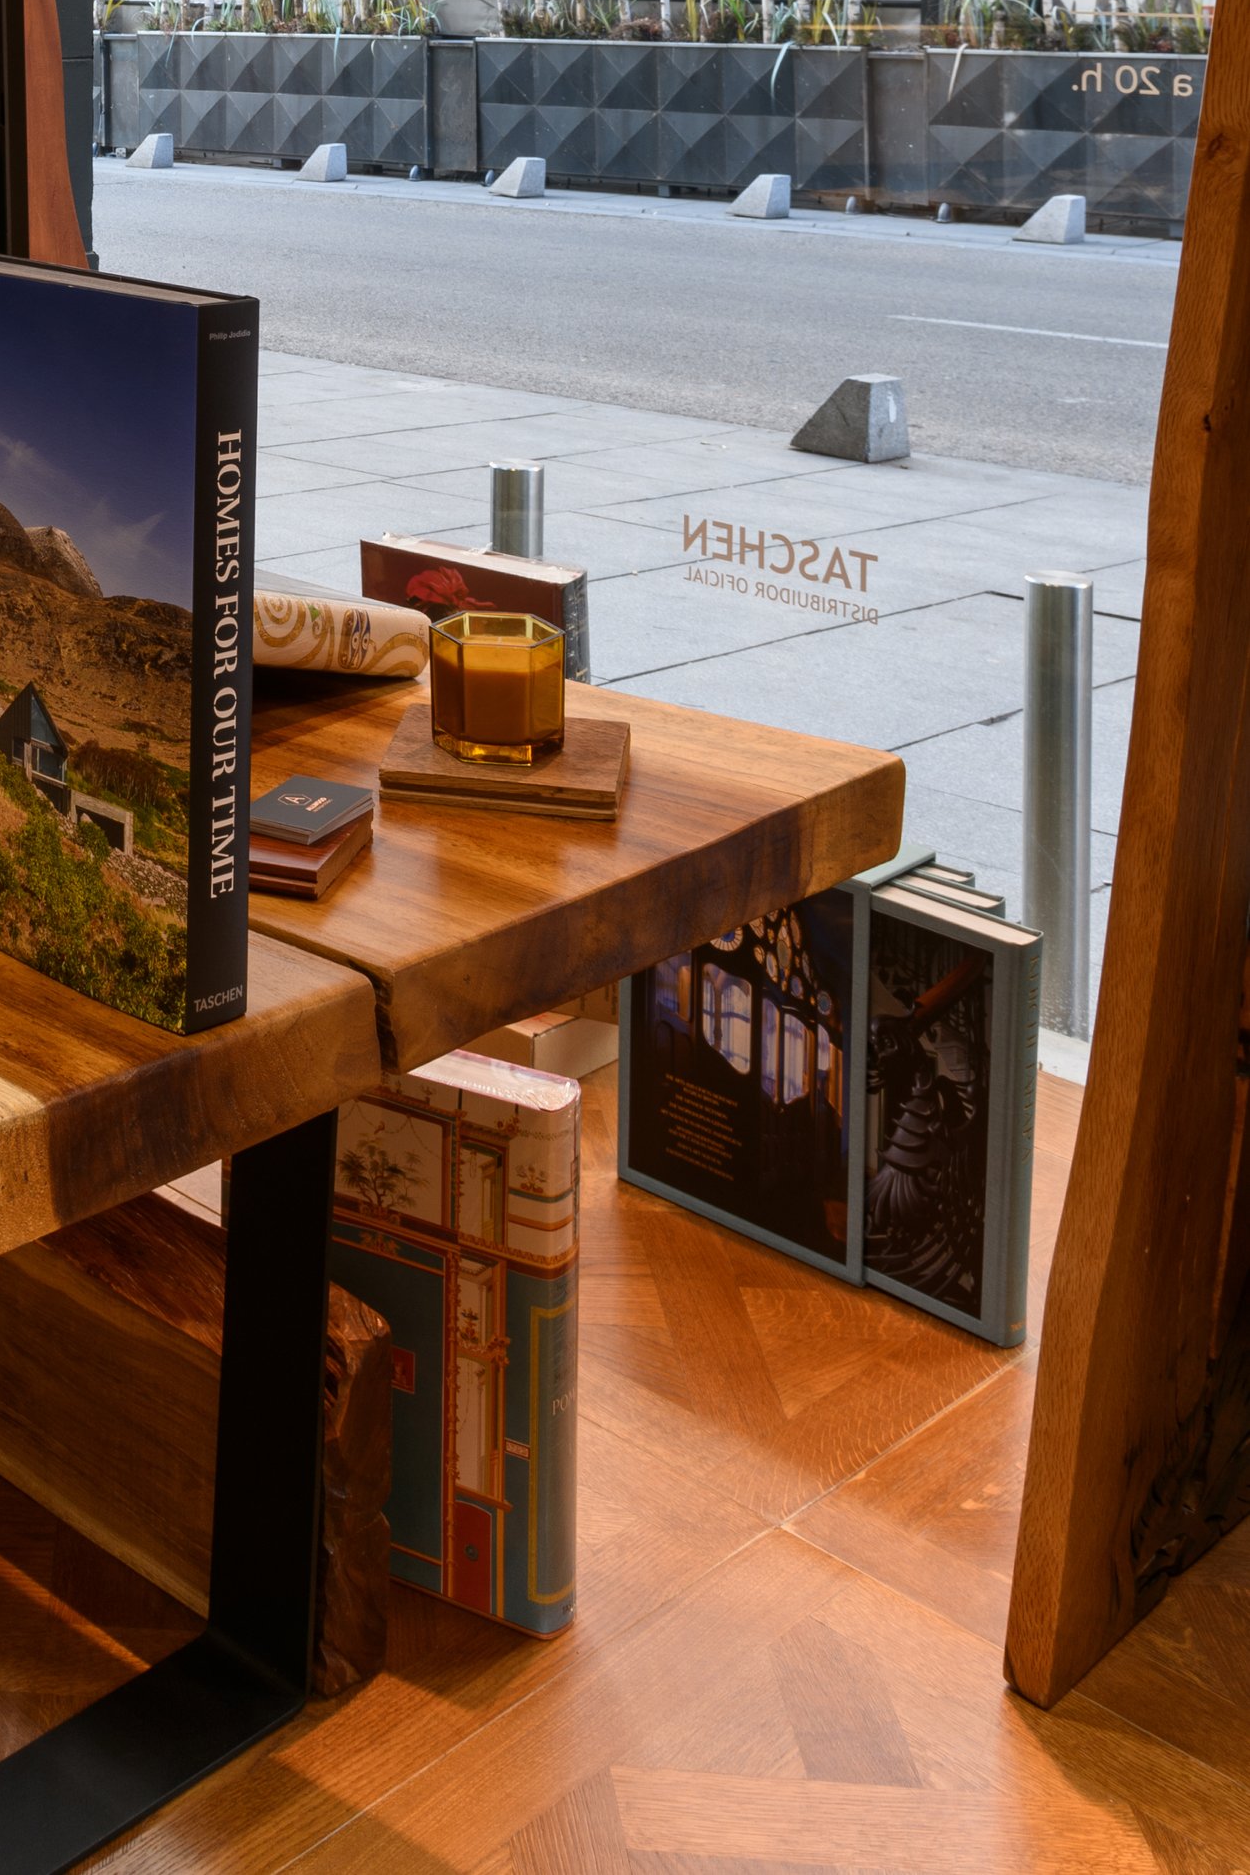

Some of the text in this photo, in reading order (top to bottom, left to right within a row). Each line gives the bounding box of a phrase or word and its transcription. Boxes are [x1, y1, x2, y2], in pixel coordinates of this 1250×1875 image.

[209, 332, 228, 341] Philip
[210, 428, 242, 899] HOMES FOR OUR TIME
[194, 984, 243, 1013] TASCHEN
